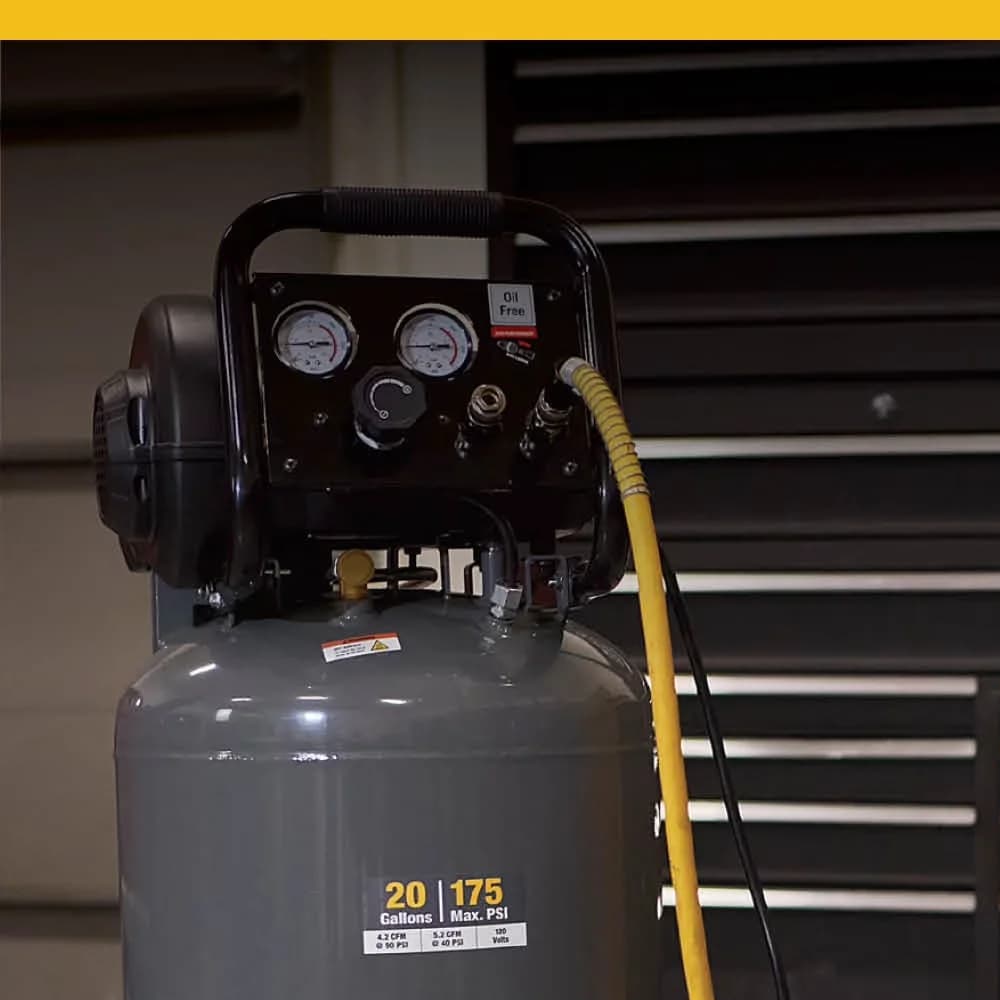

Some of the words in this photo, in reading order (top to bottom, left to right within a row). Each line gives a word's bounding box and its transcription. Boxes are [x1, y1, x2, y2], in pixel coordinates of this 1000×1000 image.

[504, 291, 518, 302] Oil
[500, 305, 525, 315] Free
[386, 881, 426, 909] 20
[451, 878, 504, 906] 175
[380, 912, 432, 925] Gallons
[451, 909, 483, 922] Max.
[487, 907, 508, 920] PSI
[447, 930, 462, 938] CFM
[452, 938, 463, 946] PSI
[492, 936, 509, 944] Volts
